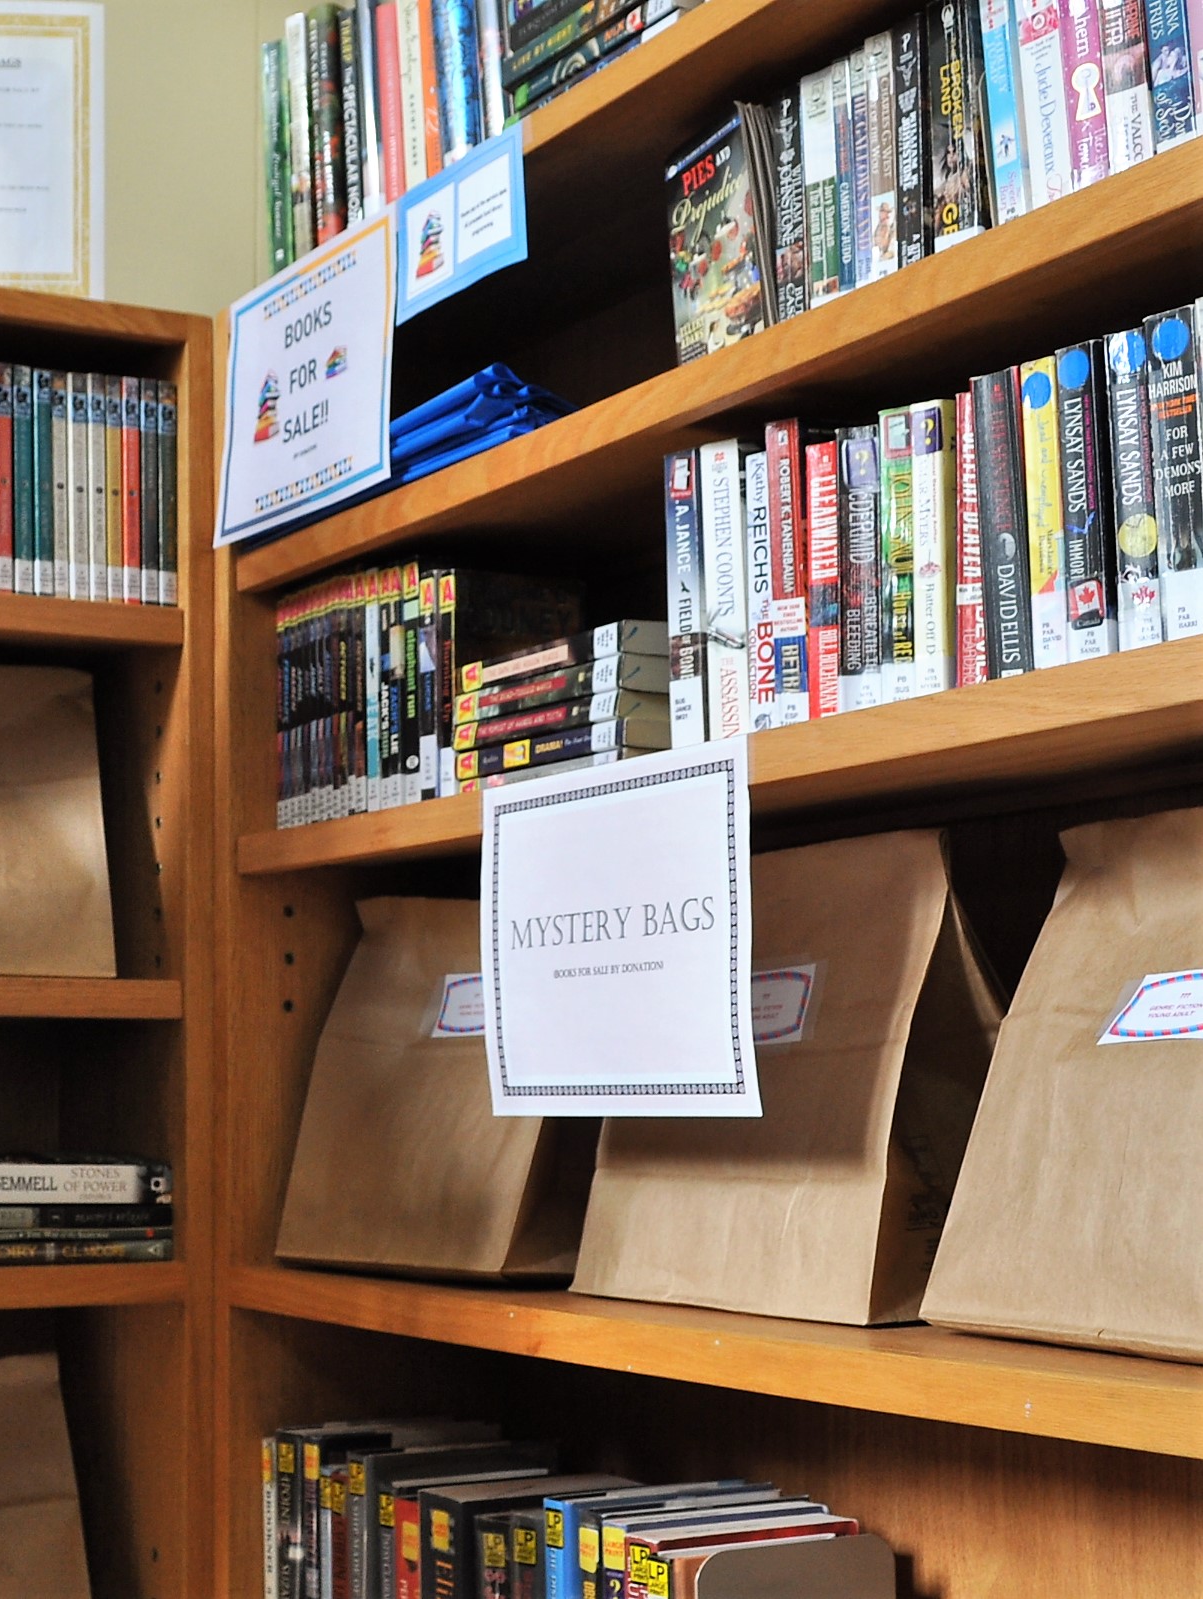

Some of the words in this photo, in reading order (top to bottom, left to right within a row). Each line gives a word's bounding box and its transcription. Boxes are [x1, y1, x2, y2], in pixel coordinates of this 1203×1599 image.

[880, 76, 891, 128] CHARLES
[940, 64, 952, 115] LAND
[953, 60, 964, 139] BROKEN
[1035, 62, 1052, 101] Jude
[343, 84, 361, 186] SPECTACULAR
[881, 130, 892, 146] G.
[900, 116, 912, 191] JOHNSTONE
[1040, 105, 1057, 175] Deveraux
[682, 154, 716, 197] PIES
[715, 146, 732, 167] AND
[854, 122, 868, 200] GALLOWS
[883, 149, 894, 177] WEST
[672, 165, 746, 245] Prejudice
[776, 164, 794, 247] JOHNSTONE
[791, 163, 803, 223] WILLIAM
[810, 190, 822, 208] The
[823, 184, 834, 205] Jory
[839, 182, 850, 234] CAMERON
[810, 208, 823, 233] Baron
[825, 206, 836, 248] Sherman
[856, 203, 871, 250] LAND
[811, 234, 824, 263] Brand
[841, 235, 853, 265] JUDD
[284, 301, 332, 349] BOOKS
[289, 359, 317, 394] FOR
[1148, 374, 1197, 399] HARRISON
[1162, 361, 1183, 378] KIM
[283, 400, 329, 444] SALE!!
[1063, 397, 1086, 455] LYNSAY
[1116, 389, 1139, 444] LYNSAY
[1165, 425, 1189, 442] FOR
[1154, 460, 1202, 480] DEMONS
[1160, 448, 1169, 461] A
[1170, 442, 1194, 459] FEW
[752, 461, 767, 503] Kathy
[779, 457, 792, 503] ROBERT
[889, 468, 912, 526] JOHN
[1066, 460, 1086, 513] SANDS
[1122, 450, 1143, 506] SANDS
[1163, 480, 1195, 498] MORE
[713, 478, 733, 548] STEPHEN
[781, 504, 792, 516] K.
[810, 475, 837, 580] CLEARWATER
[918, 499, 931, 547] MYERS
[675, 524, 691, 574] JANCE
[752, 507, 769, 594] REICHS
[781, 517, 794, 593] TANENBAUM
[716, 552, 735, 617] COONTS
[997, 564, 1017, 617] DAVID
[678, 598, 692, 633] FIELD
[761, 599, 770, 619] THE
[864, 596, 876, 653] BENEATH
[924, 621, 936, 638] Off
[406, 629, 416, 691] elephant
[819, 628, 837, 652] BILL
[847, 608, 861, 669] BLEEDING
[1001, 621, 1021, 663] ELLIS
[748, 628, 757, 700] COLLECTION
[757, 622, 776, 704] BONE
[819, 653, 838, 708] BUCHANAN
[380, 682, 389, 730] JACK'S
[407, 693, 416, 718] run
[390, 734, 399, 754] LIE
[511, 906, 632, 950] MYSTERY
[642, 896, 715, 937] BAGS
[578, 967, 592, 976] FOR
[592, 965, 610, 976] SALE
[610, 964, 620, 975] BY
[63, 1180, 79, 1192] OF
[83, 1180, 127, 1192] POWER
[69, 1167, 120, 1178] STONES
[632, 1547, 648, 1564] LP
[649, 1563, 665, 1579] LP
